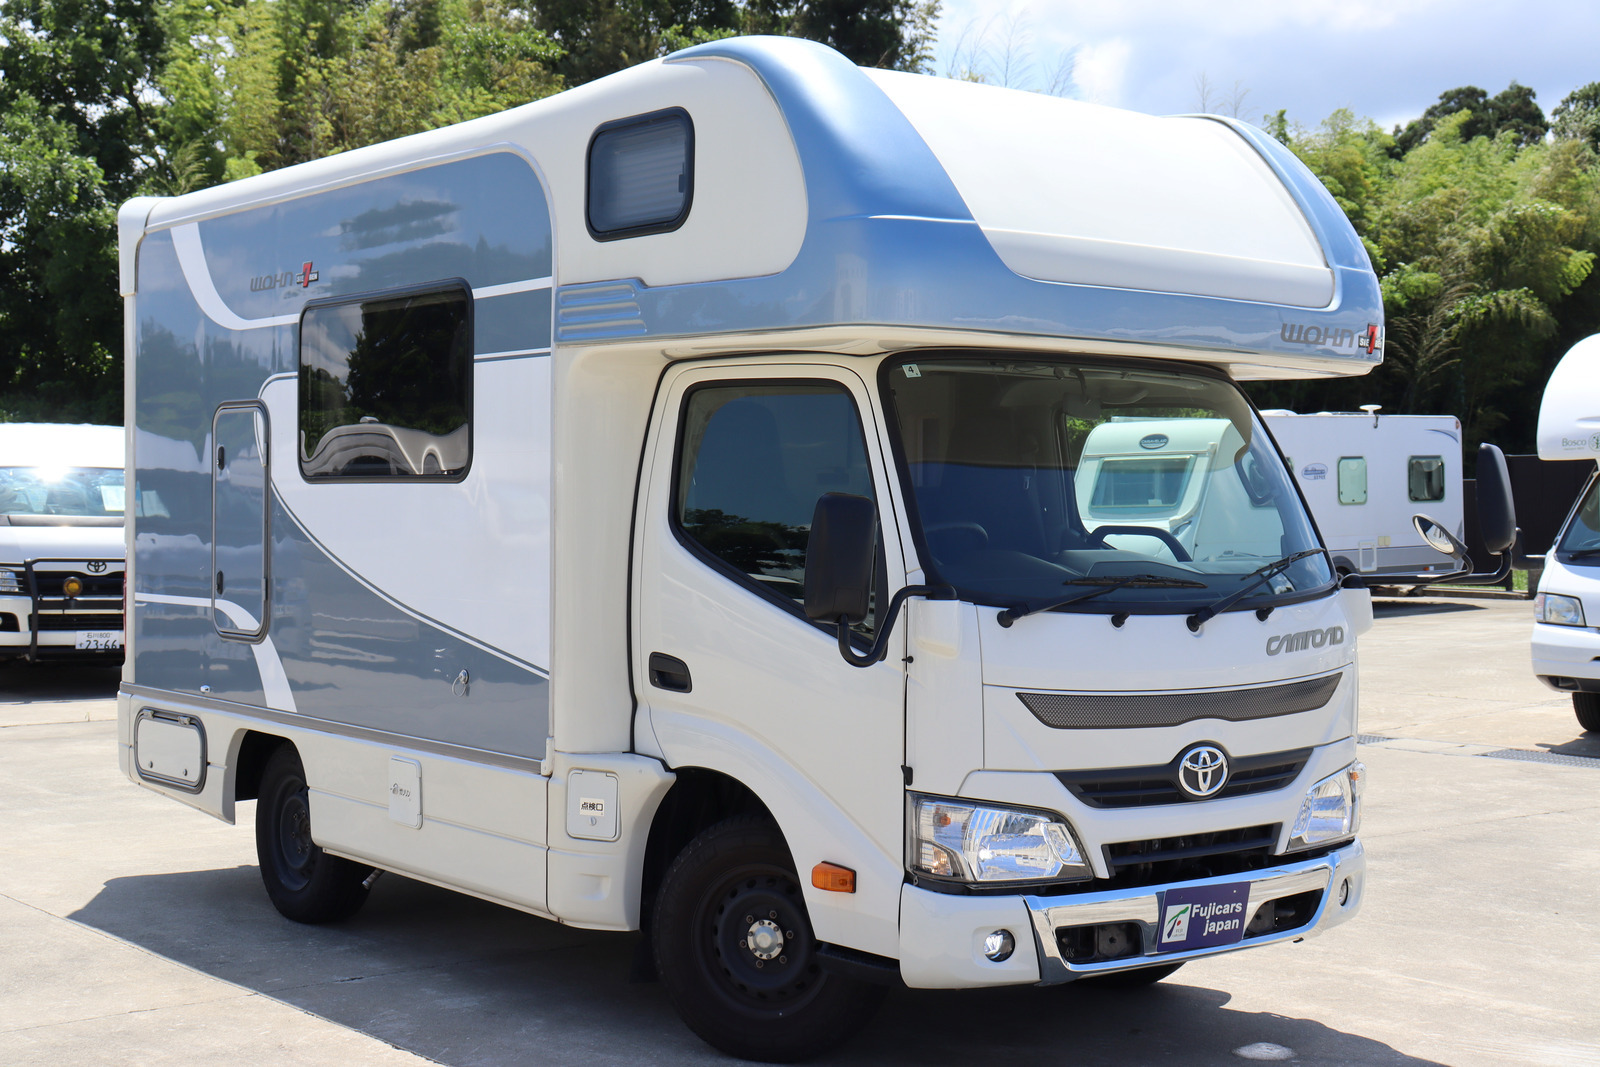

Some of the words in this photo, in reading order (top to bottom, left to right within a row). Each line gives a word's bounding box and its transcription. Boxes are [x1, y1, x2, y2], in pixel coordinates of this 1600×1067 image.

[908, 365, 914, 373] 4
[1561, 437, 1587, 447] Bosco
[580, 801, 604, 812] 点検口
[1191, 902, 1243, 919] Fujicars
[1202, 918, 1240, 937] japan
